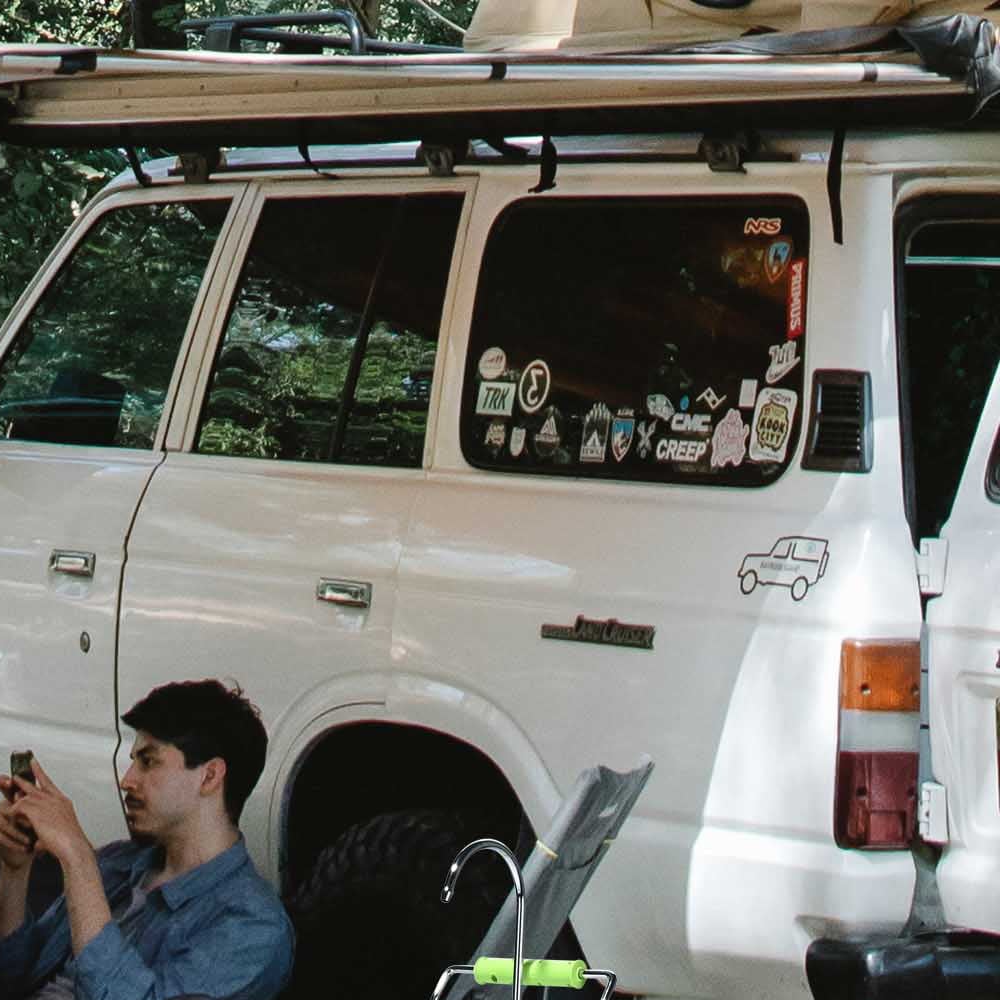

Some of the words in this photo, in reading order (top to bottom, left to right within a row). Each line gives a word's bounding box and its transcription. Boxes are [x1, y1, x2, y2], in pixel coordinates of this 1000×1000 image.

[743, 217, 782, 235] NRS
[790, 261, 804, 331] PRIMUS
[482, 386, 511, 411] TRK
